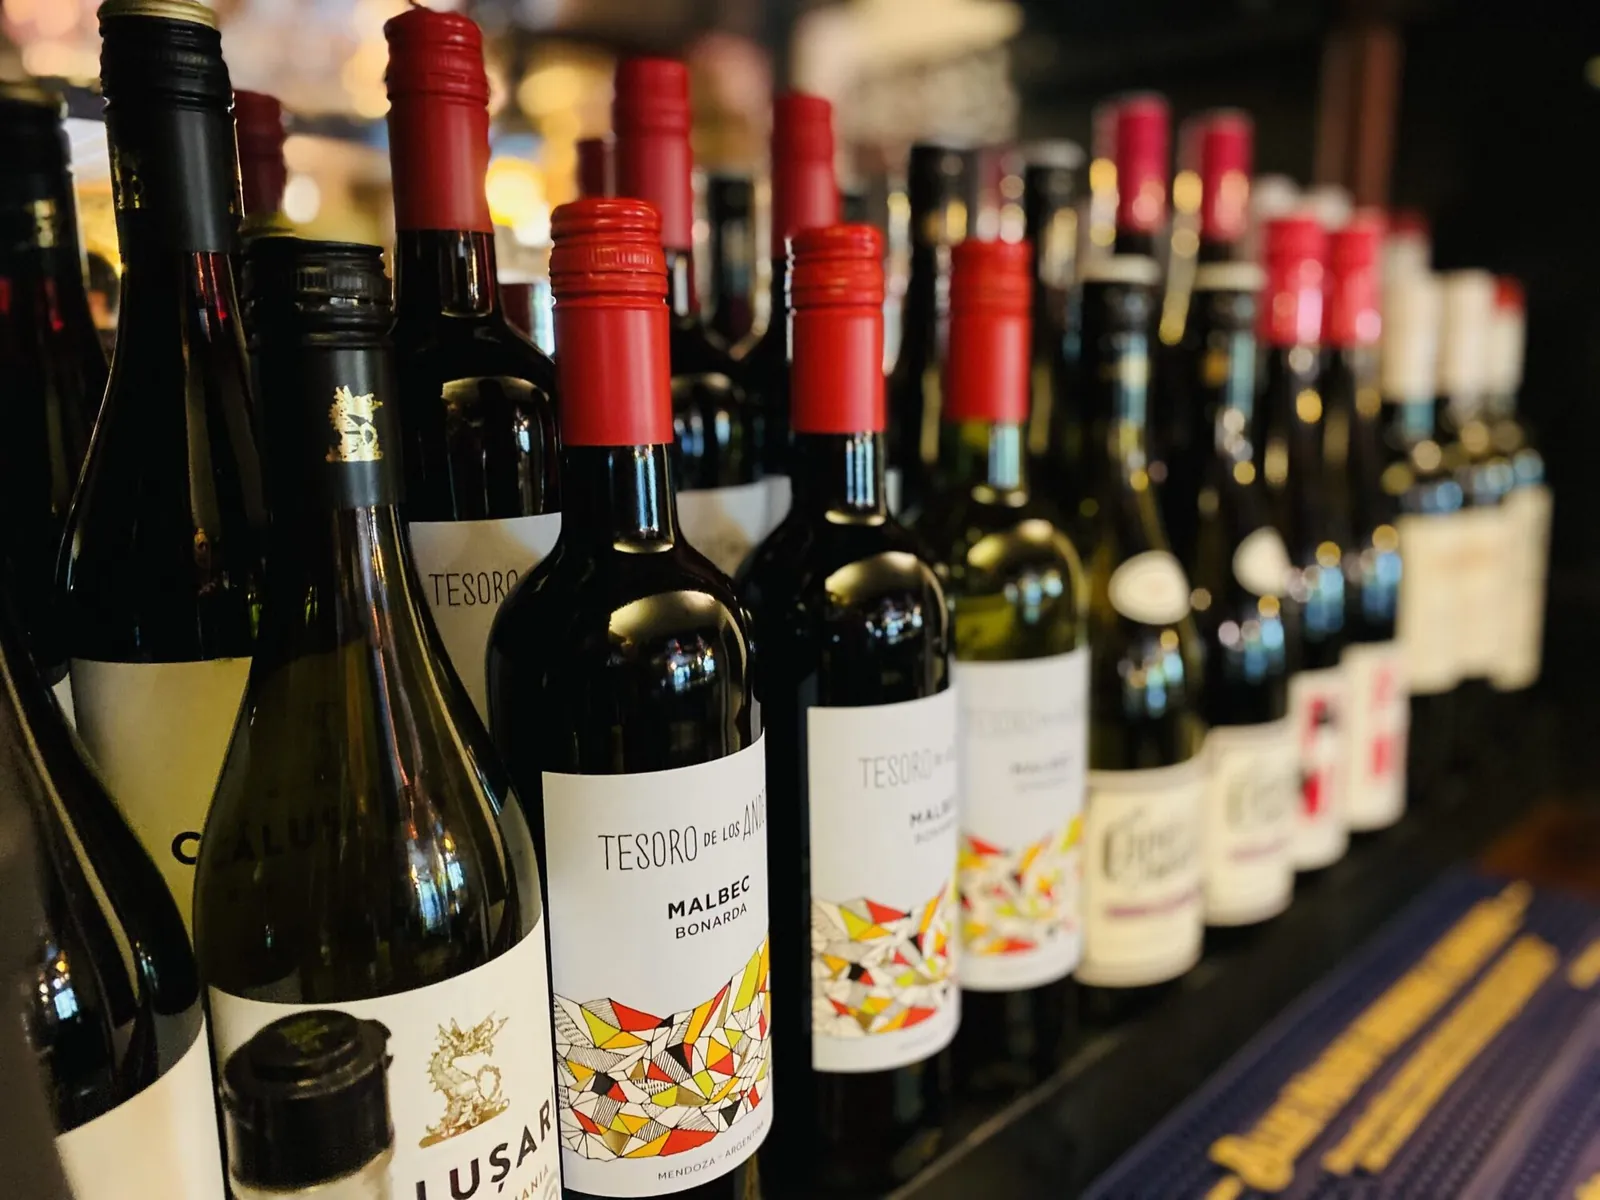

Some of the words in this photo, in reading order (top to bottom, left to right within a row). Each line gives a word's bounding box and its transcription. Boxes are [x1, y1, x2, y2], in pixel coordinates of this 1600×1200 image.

[428, 569, 519, 607] TESORO
[597, 825, 699, 871] TESORO
[703, 830, 717, 848] DE
[722, 820, 740, 842] LOS
[667, 875, 751, 920] MALBEC
[675, 902, 748, 940] BONARDA
[514, 1163, 549, 1200] ANIA
[657, 1157, 717, 1182] MENDOZA
